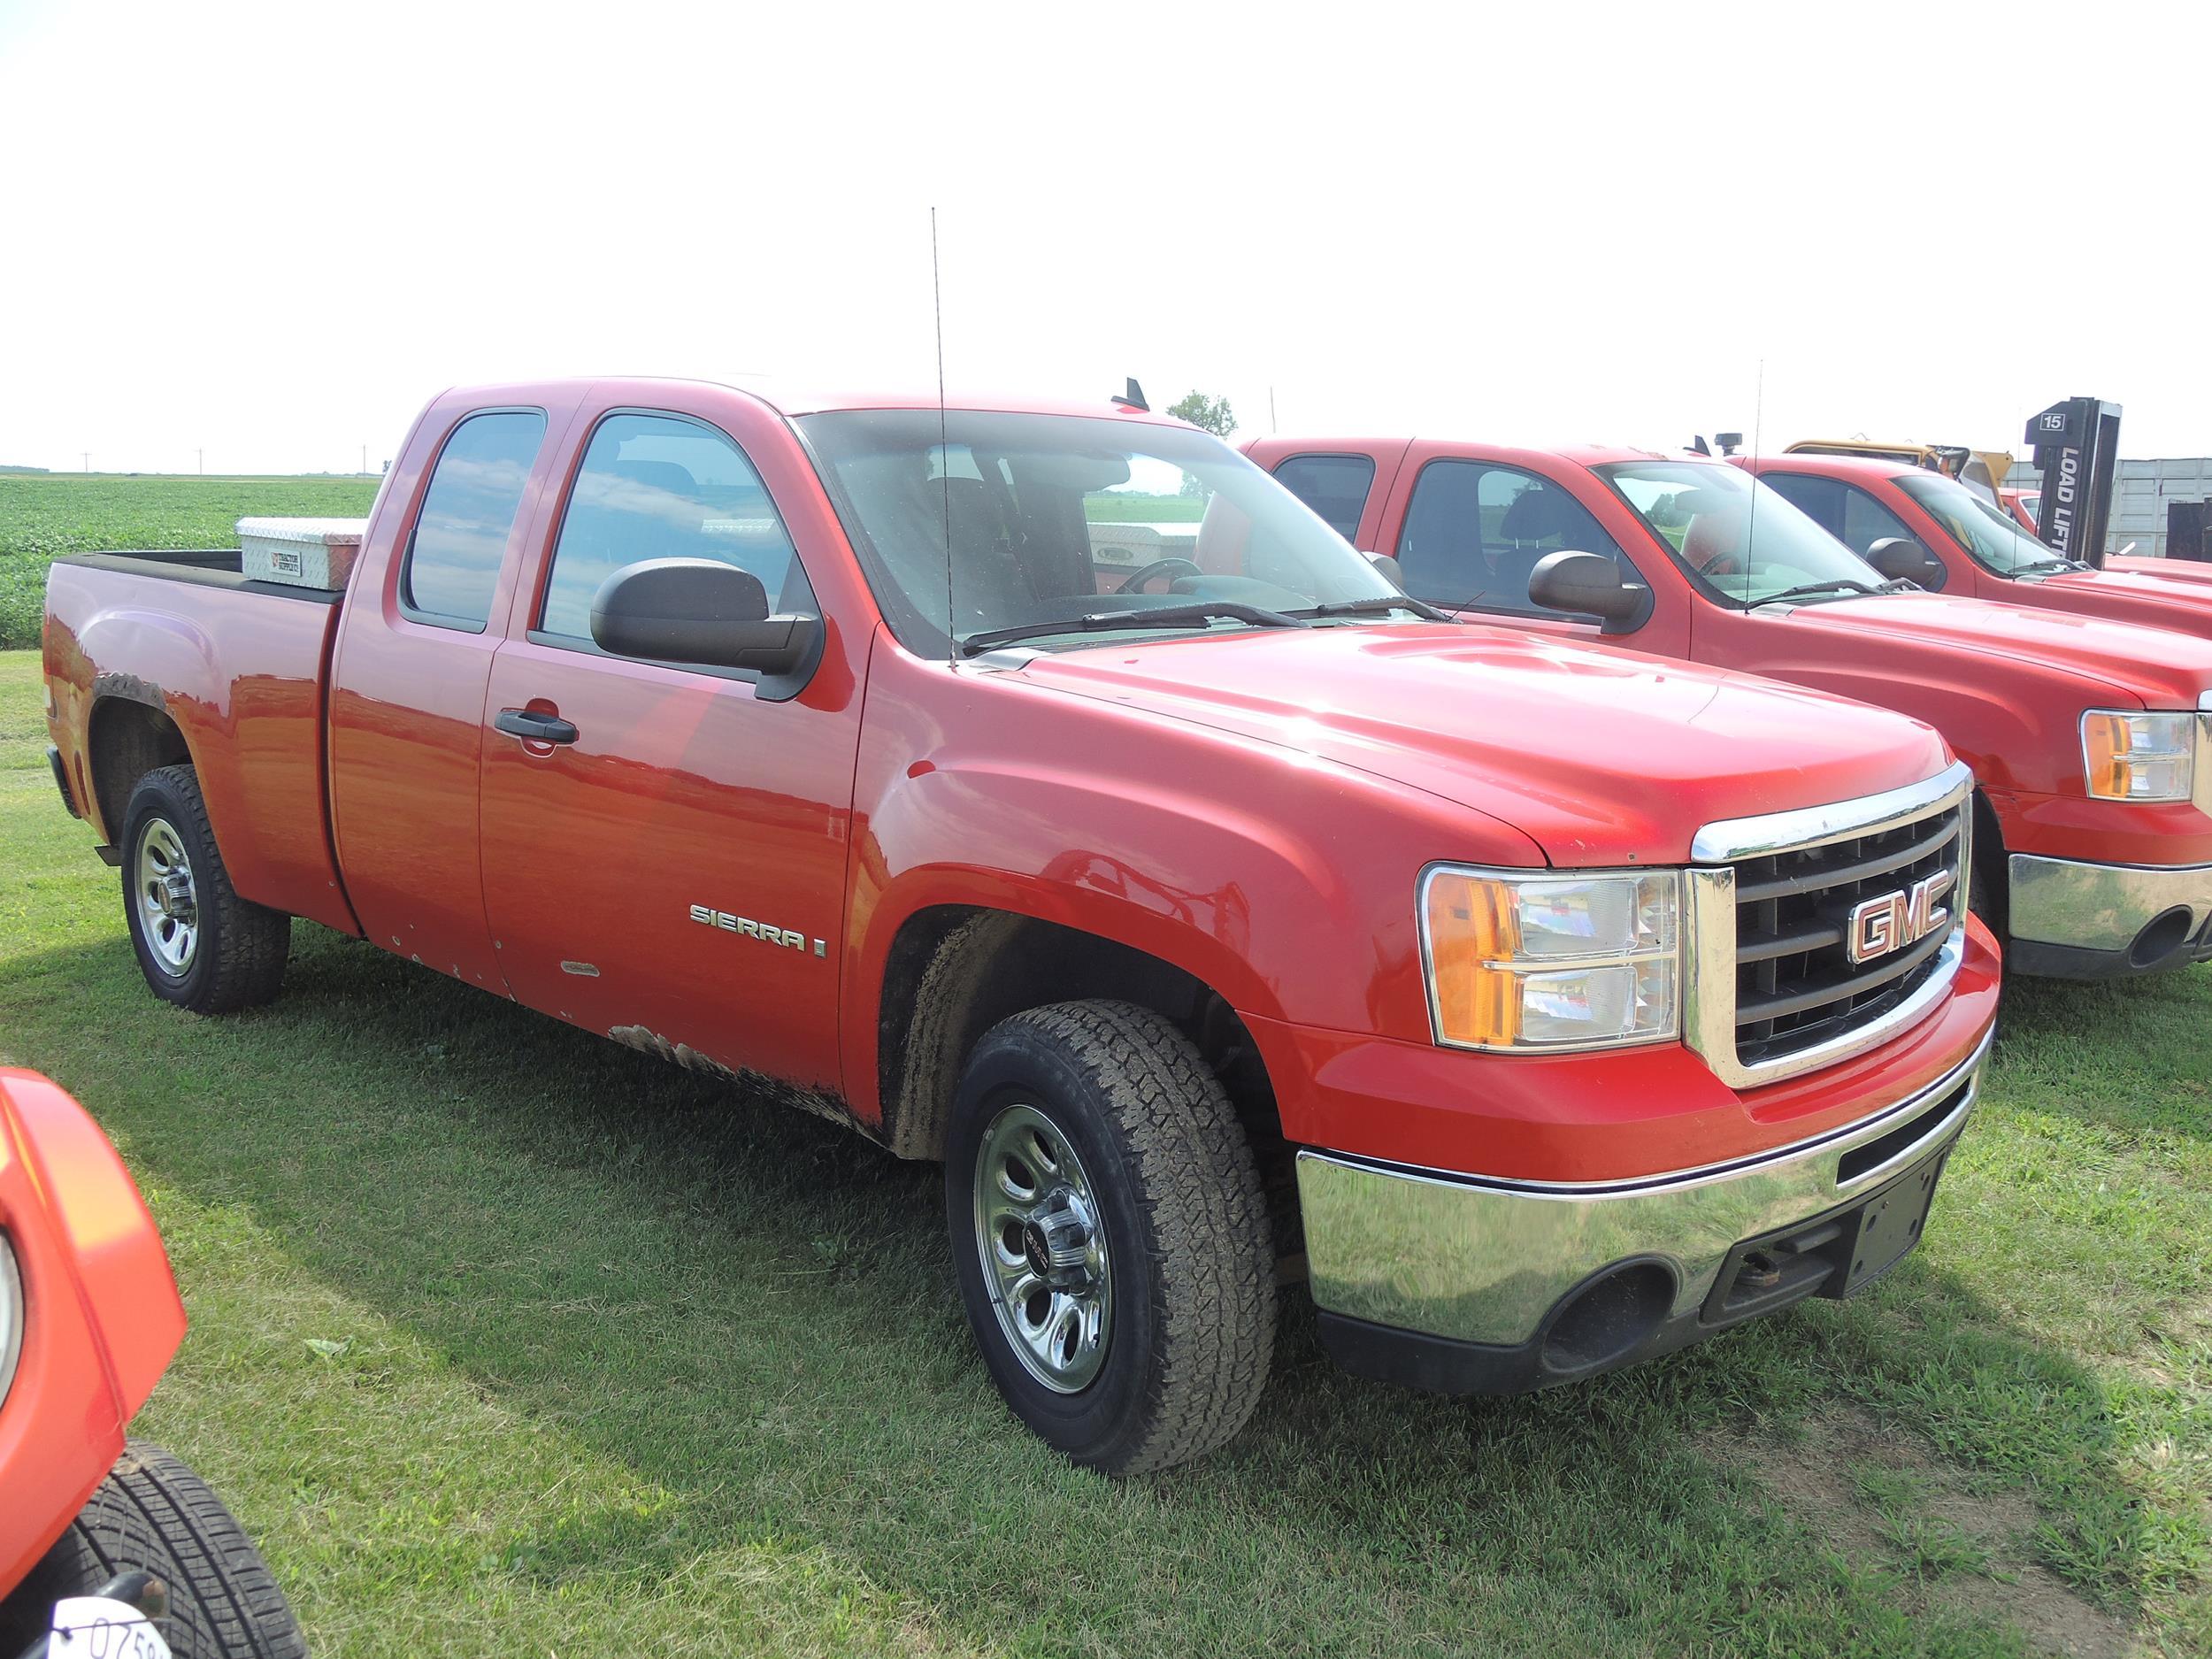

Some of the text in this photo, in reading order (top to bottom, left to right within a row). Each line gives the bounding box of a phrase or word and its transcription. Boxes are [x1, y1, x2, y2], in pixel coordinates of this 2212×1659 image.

[2044, 415, 2062, 429] 15
[2057, 447, 2078, 503] LOAD
[690, 904, 804, 951] SIERRA
[1848, 870, 1948, 964] GMC
